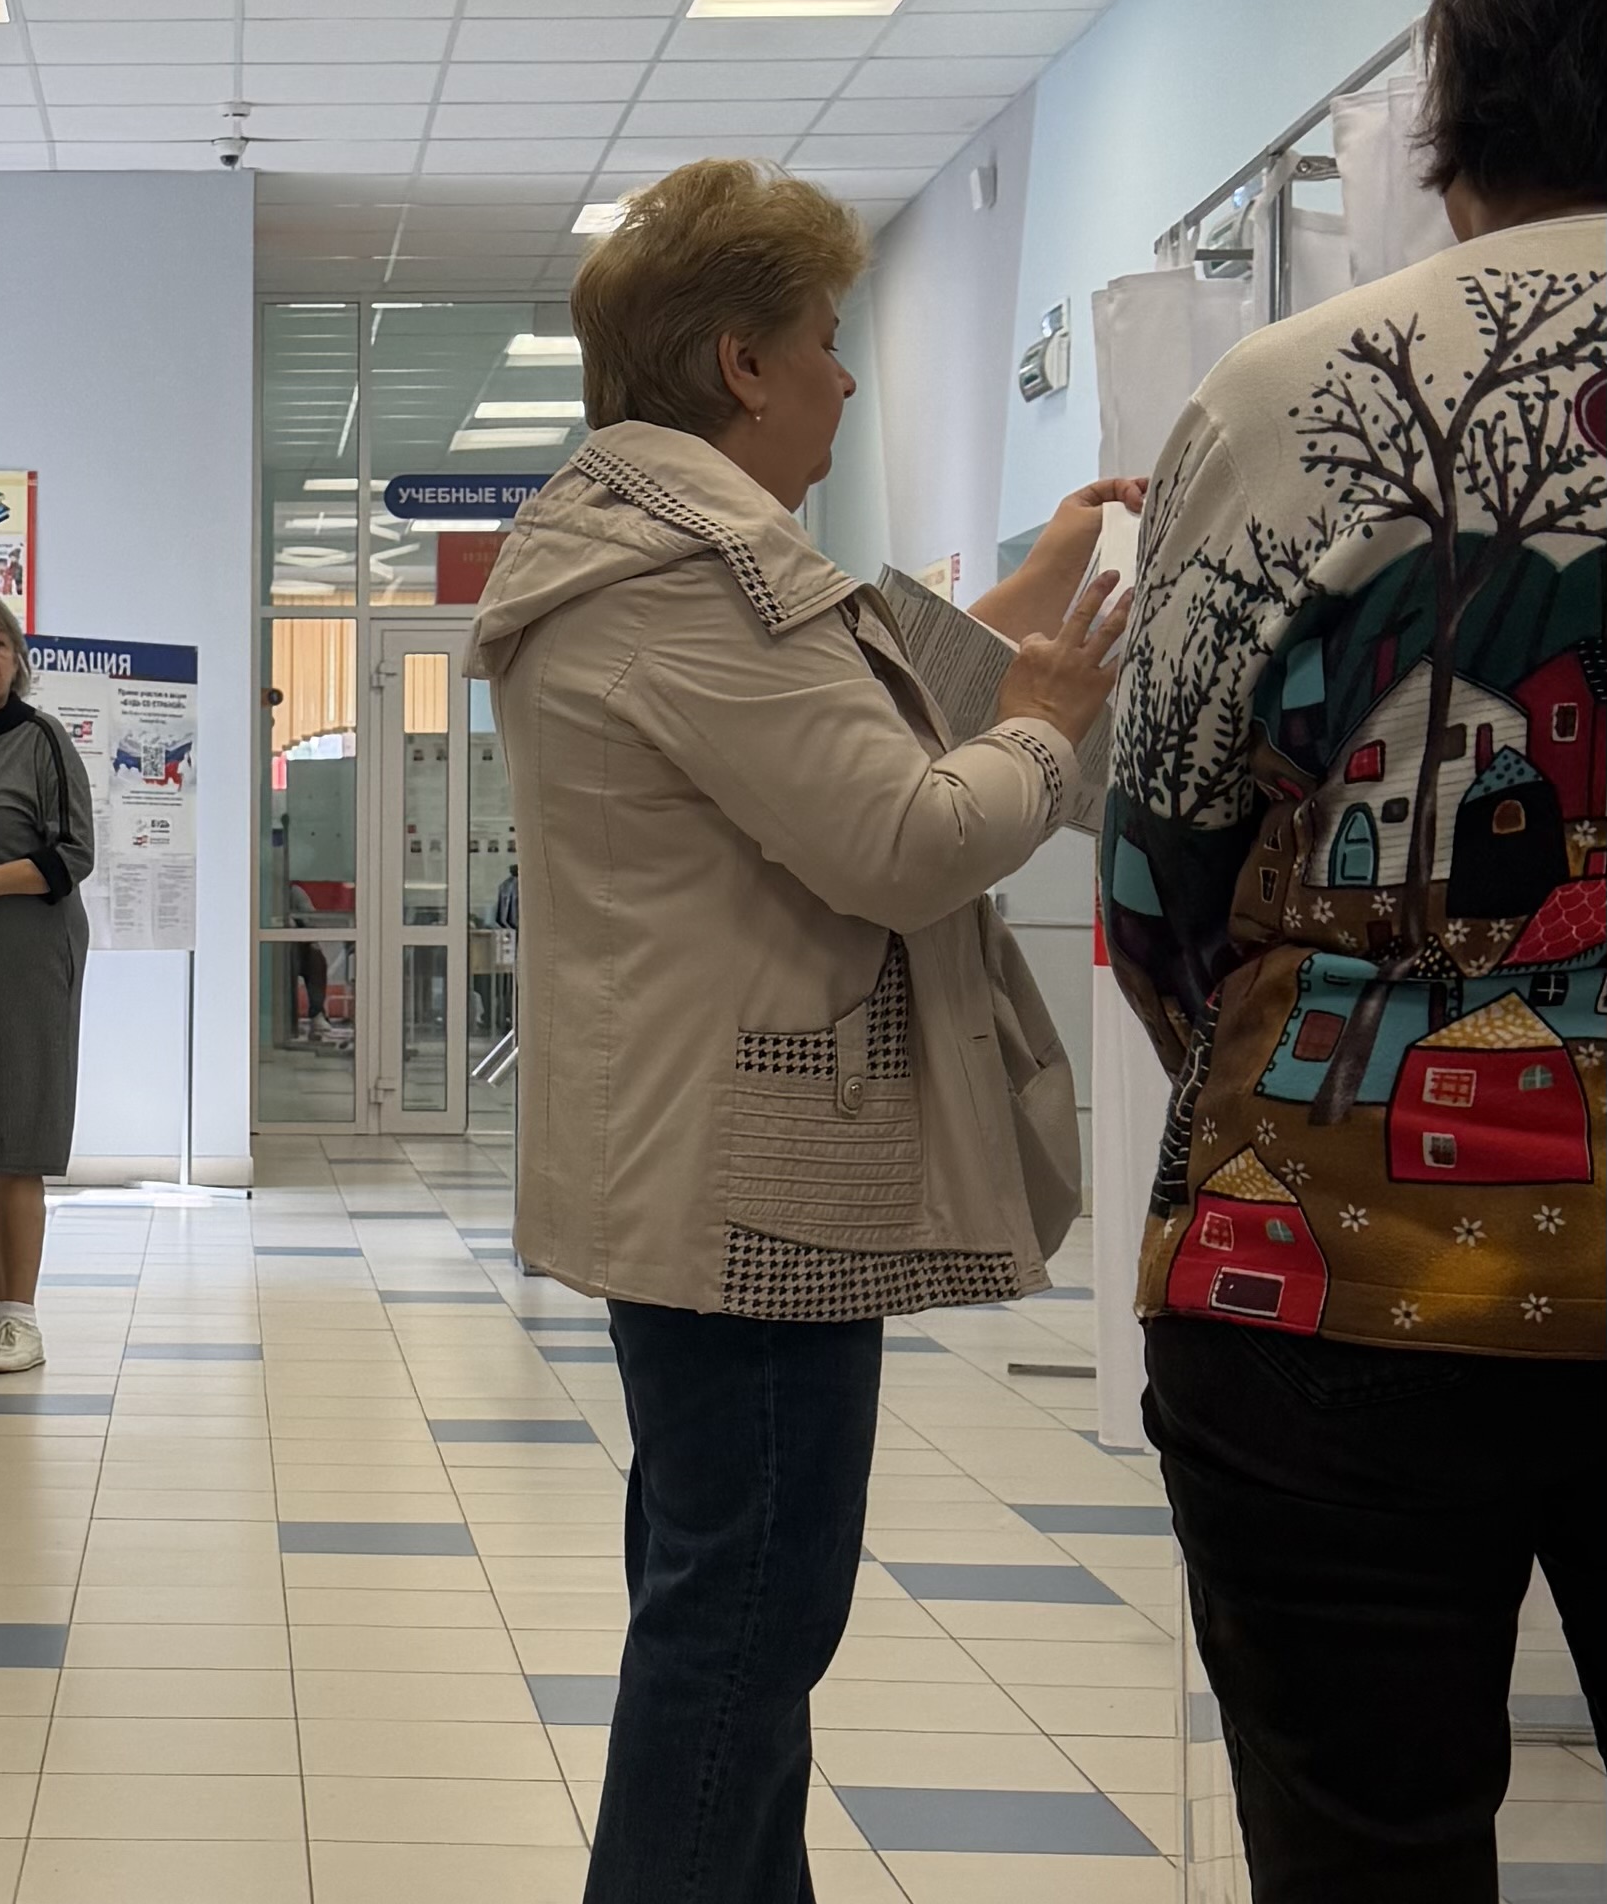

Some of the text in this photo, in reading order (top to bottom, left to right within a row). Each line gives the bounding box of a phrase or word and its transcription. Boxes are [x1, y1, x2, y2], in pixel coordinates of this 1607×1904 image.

[398, 487, 540, 504] УЧЕБНЫЕ КЛА
[29, 647, 132, 676] ОРМАЦИЯ
